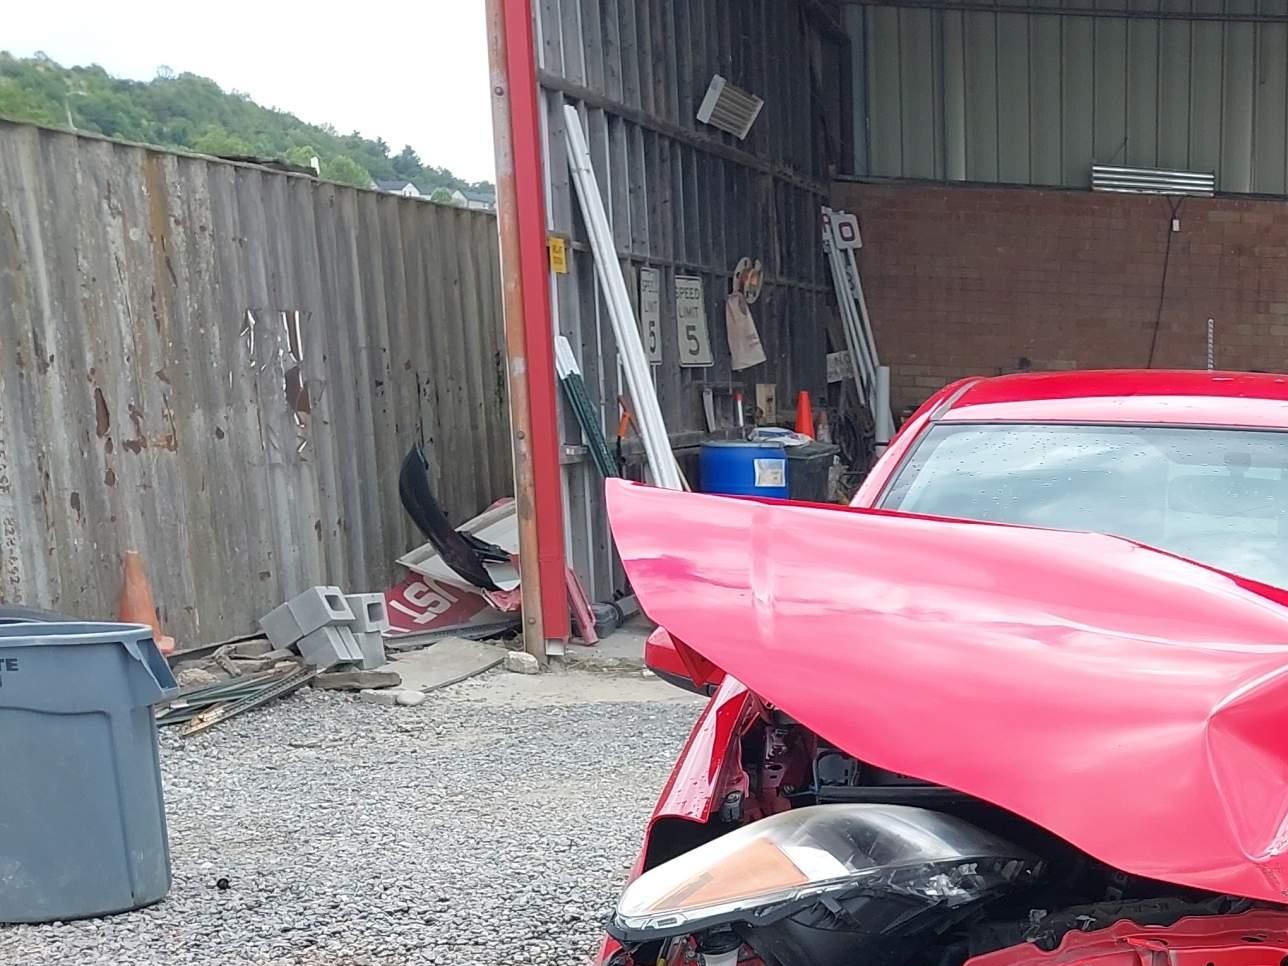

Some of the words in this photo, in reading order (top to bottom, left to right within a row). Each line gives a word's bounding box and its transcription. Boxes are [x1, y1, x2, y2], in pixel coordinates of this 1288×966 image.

[674, 287, 700, 300] SPEED
[649, 320, 657, 354] 5
[685, 325, 700, 356] 5
